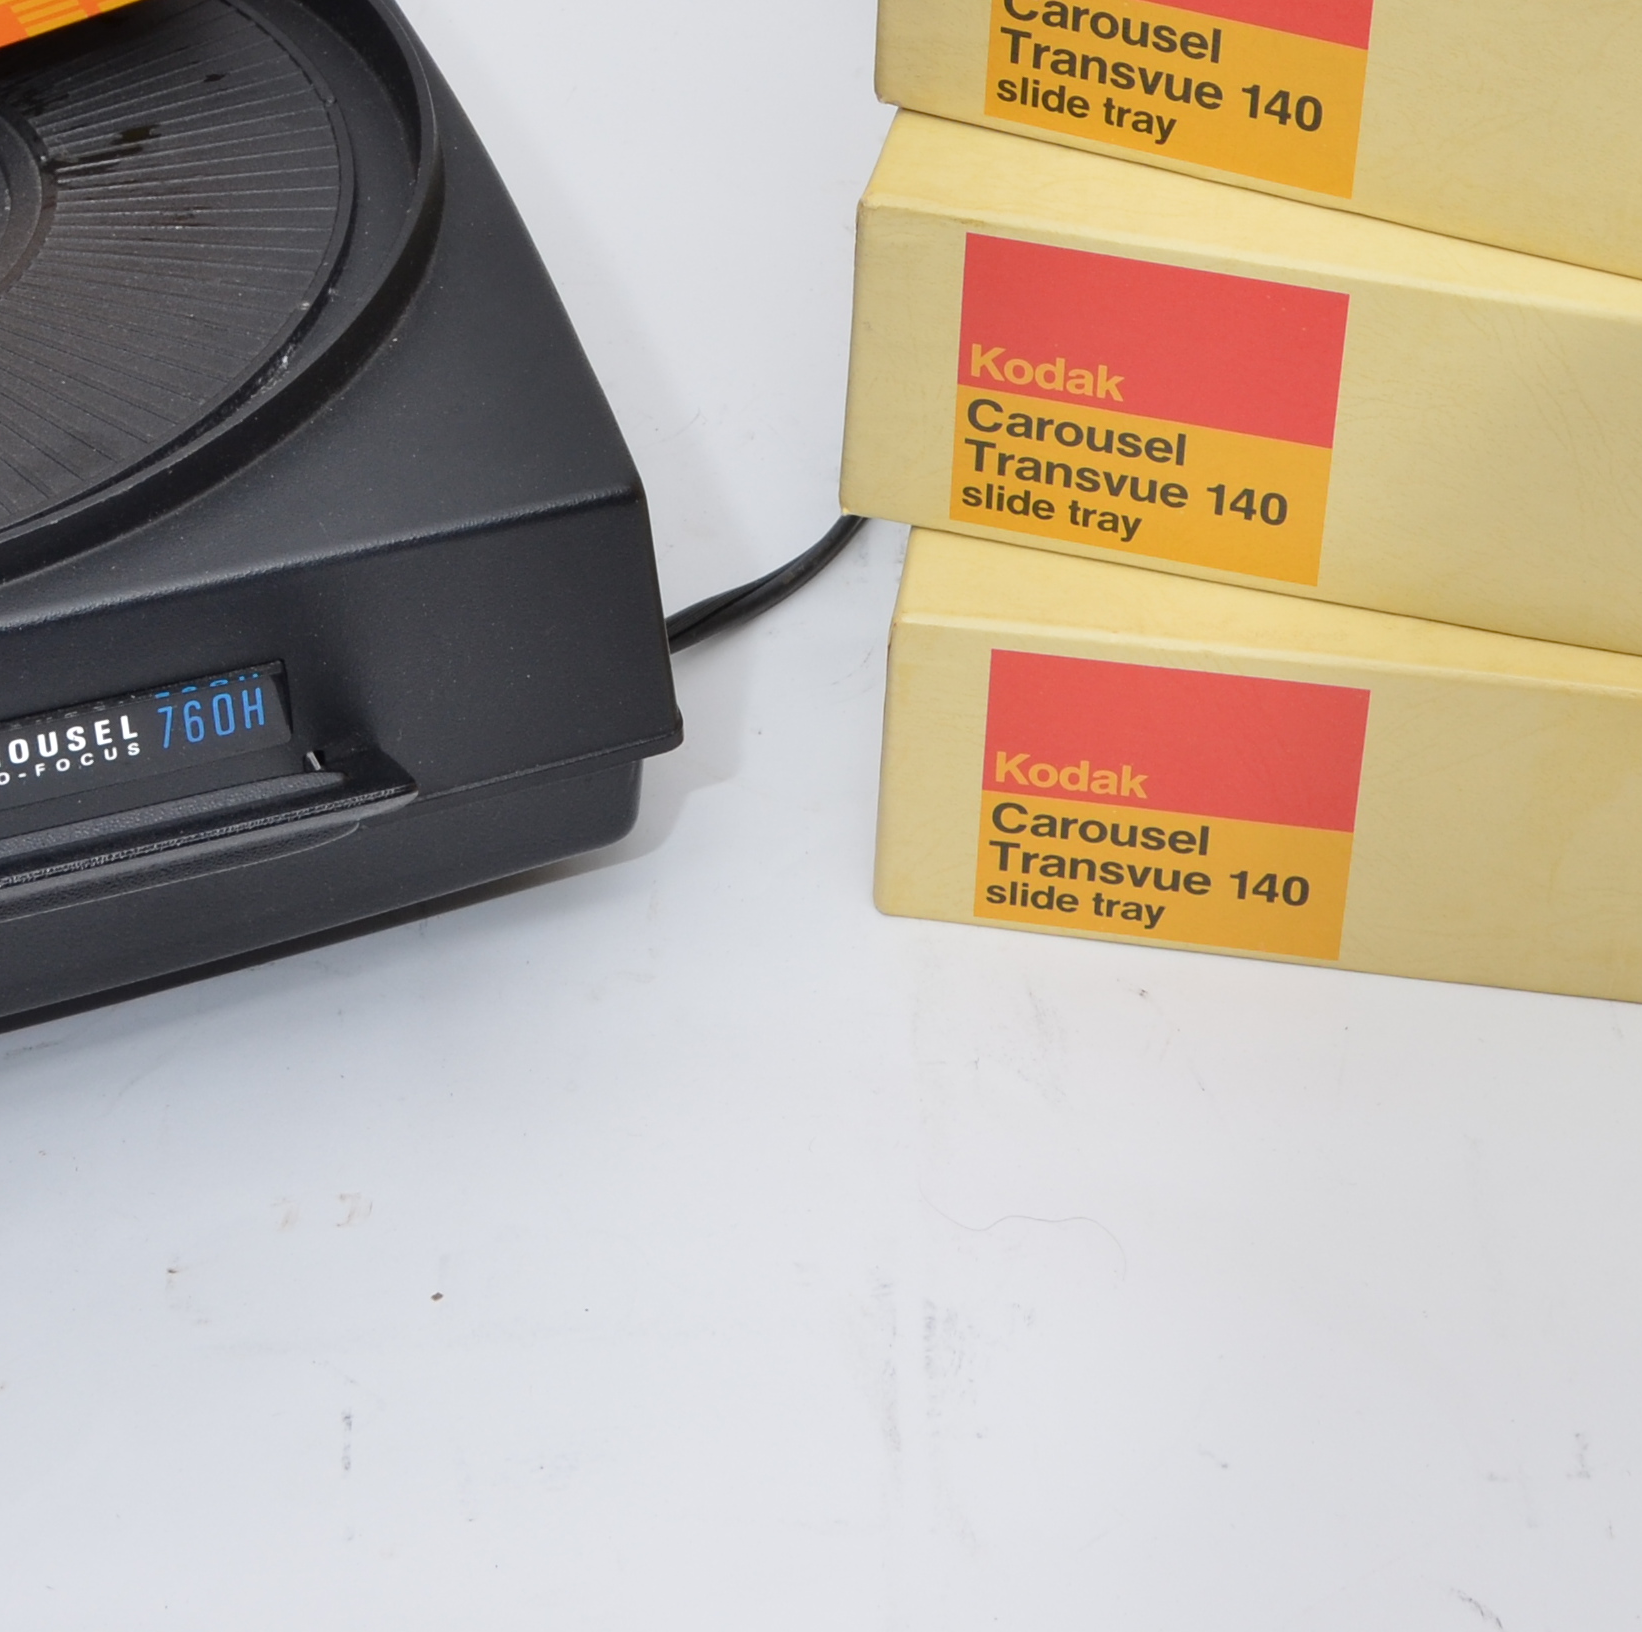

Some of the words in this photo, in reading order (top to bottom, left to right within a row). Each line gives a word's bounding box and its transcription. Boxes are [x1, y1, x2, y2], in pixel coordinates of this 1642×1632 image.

[1000, 27, 1223, 110] Transvue
[1242, 84, 1323, 132] 140
[996, 77, 1090, 118] slide
[1103, 97, 1177, 145] tray
[970, 343, 1125, 402] Kodak
[967, 398, 1187, 467] Carousel
[962, 483, 1055, 520] slide
[1068, 500, 1142, 543] tray
[964, 438, 1188, 509] Transvue
[1206, 484, 1287, 526] 140
[157, 687, 265, 749] 760H
[995, 751, 1148, 799] Kodak
[991, 802, 1209, 856] Carousel
[989, 841, 1211, 896] Transvue
[1230, 870, 1309, 907] 140
[986, 881, 1079, 913] slide
[1093, 893, 1166, 930] tray
